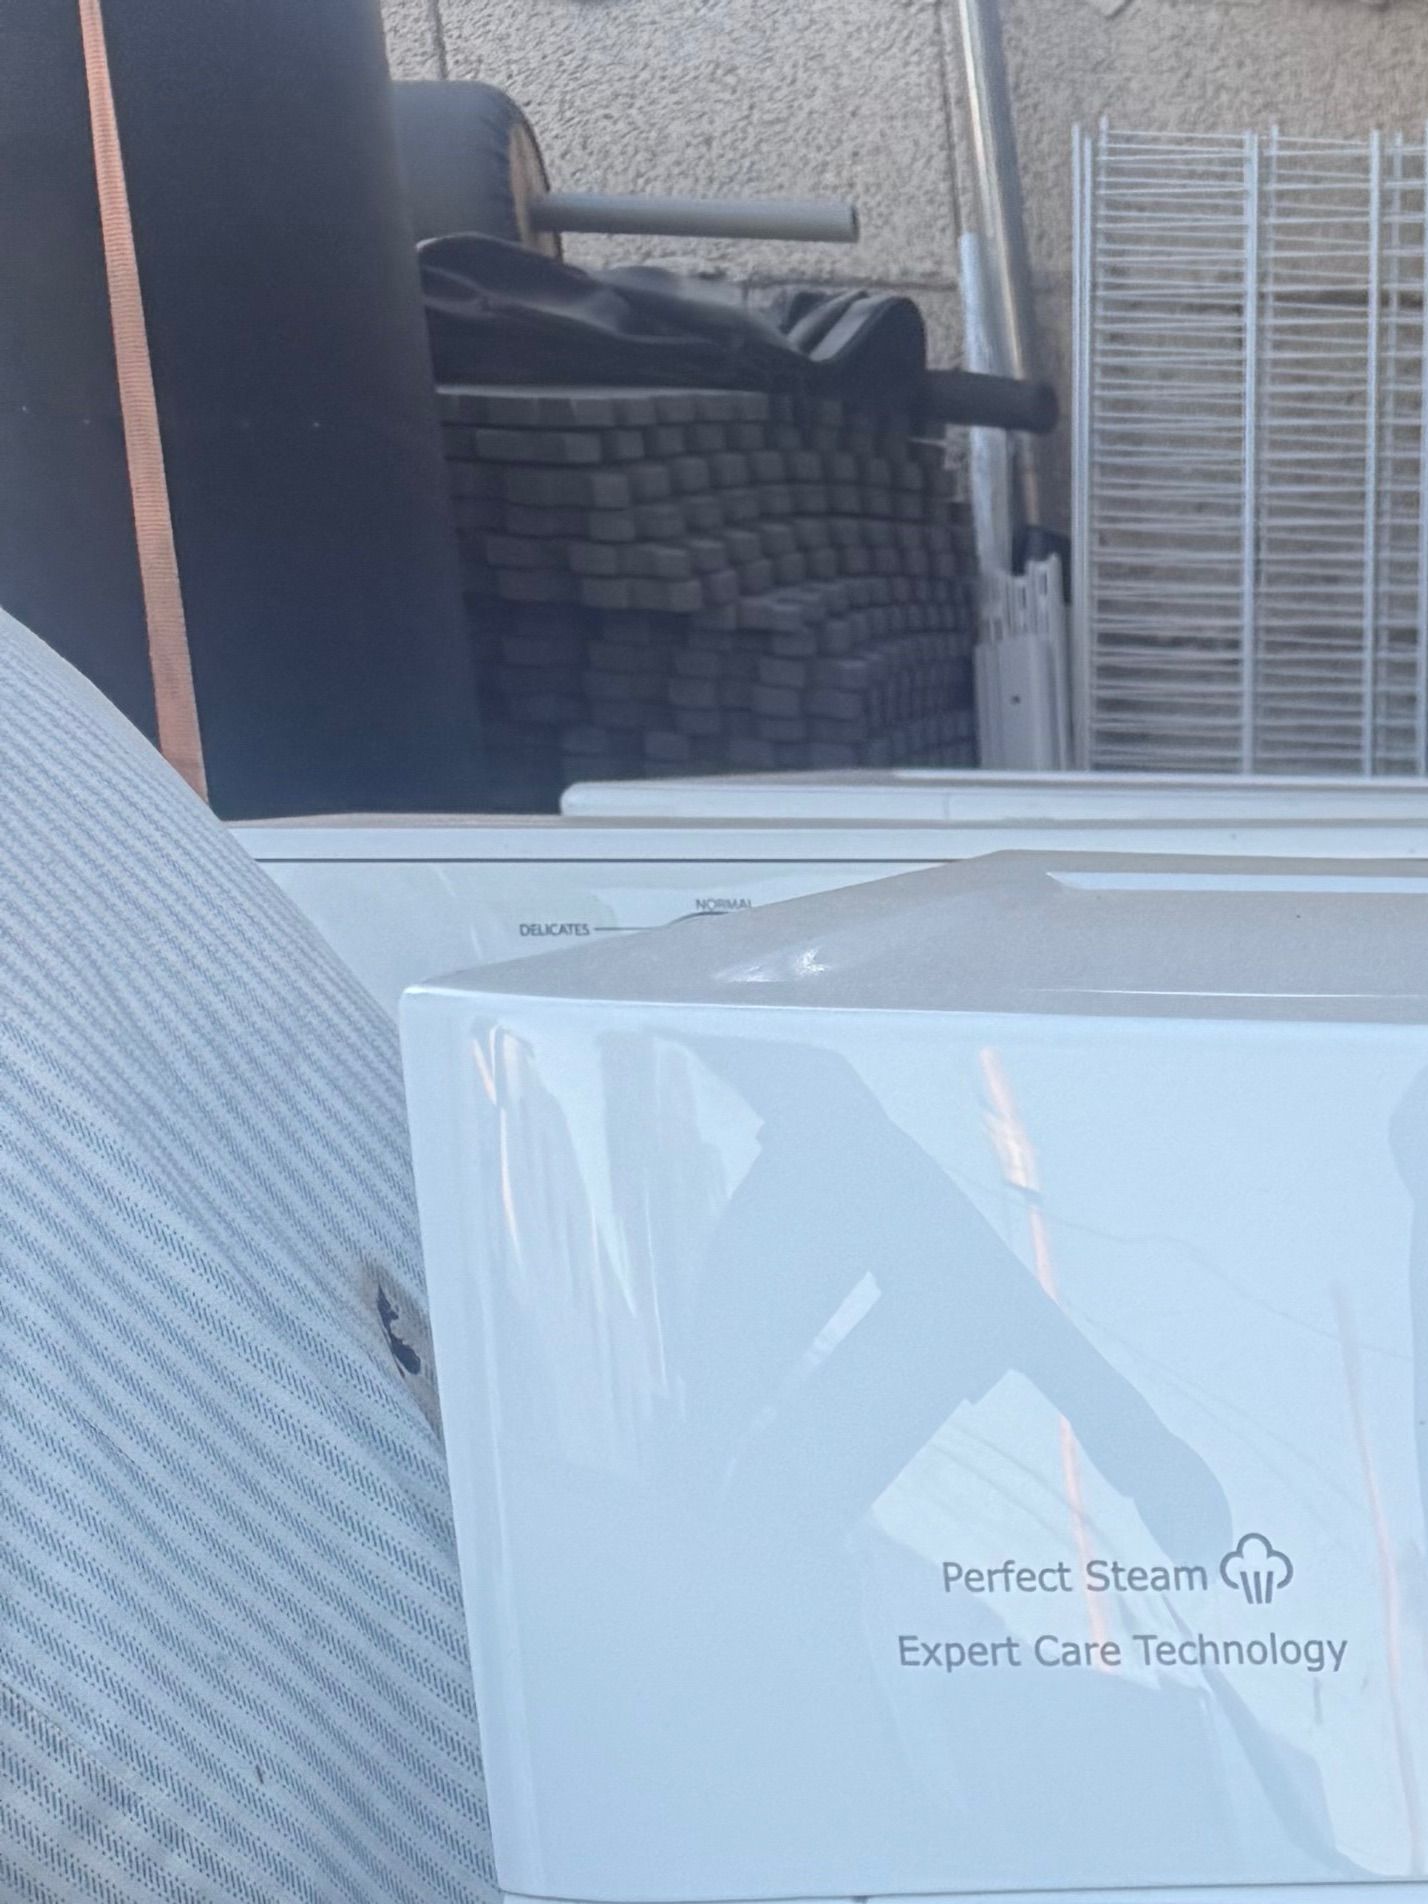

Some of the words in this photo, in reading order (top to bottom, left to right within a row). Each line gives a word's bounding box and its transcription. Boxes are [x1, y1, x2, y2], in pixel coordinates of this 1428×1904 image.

[520, 923, 590, 937] DELICATES
[943, 1561, 1071, 1593] Perfect
[1085, 1561, 1208, 1592] Steam
[899, 1635, 1021, 1672] Expert
[1034, 1636, 1121, 1667] Care
[1132, 1633, 1347, 1672] Technology
